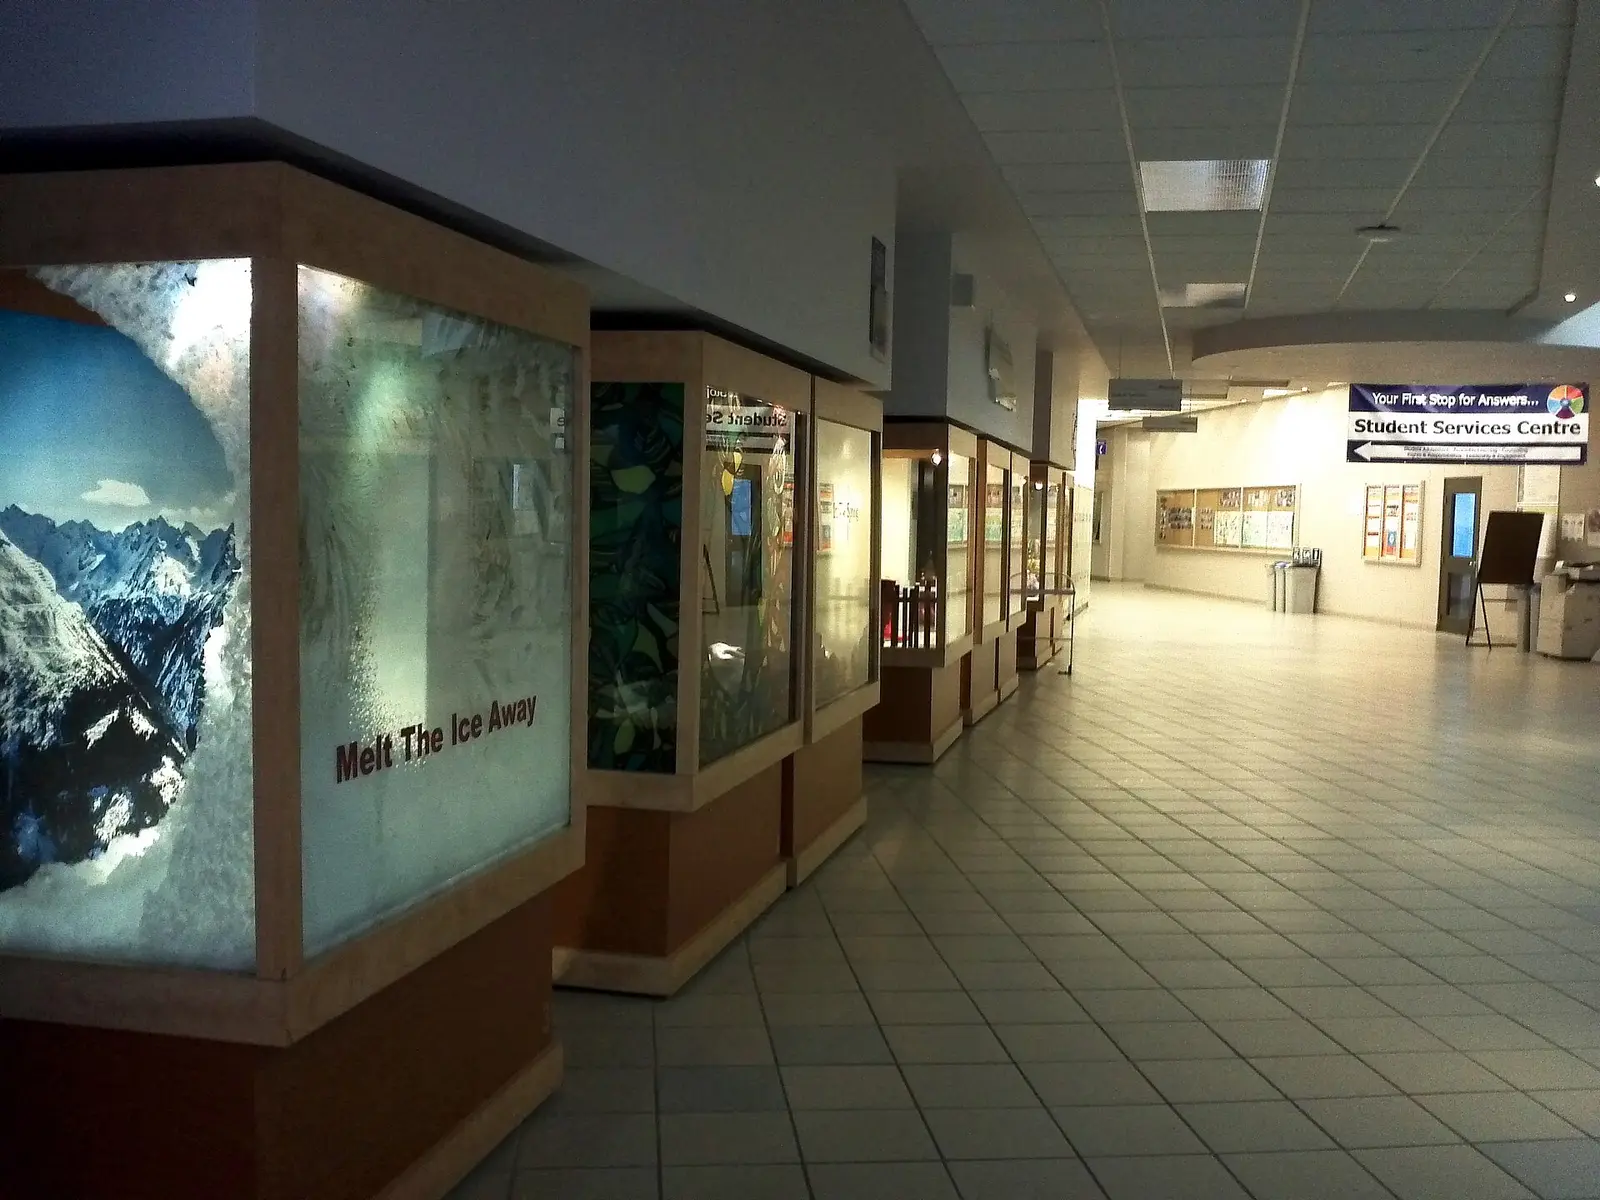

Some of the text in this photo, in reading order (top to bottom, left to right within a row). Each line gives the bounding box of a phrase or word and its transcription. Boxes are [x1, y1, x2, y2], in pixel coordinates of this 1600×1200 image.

[1372, 392, 1398, 405] Your
[1402, 392, 1427, 405] First
[1429, 393, 1455, 408] Stop
[1458, 392, 1476, 406] for
[1354, 418, 1581, 435] Student Services Centre
[336, 695, 537, 784] Melt The Ice Away
